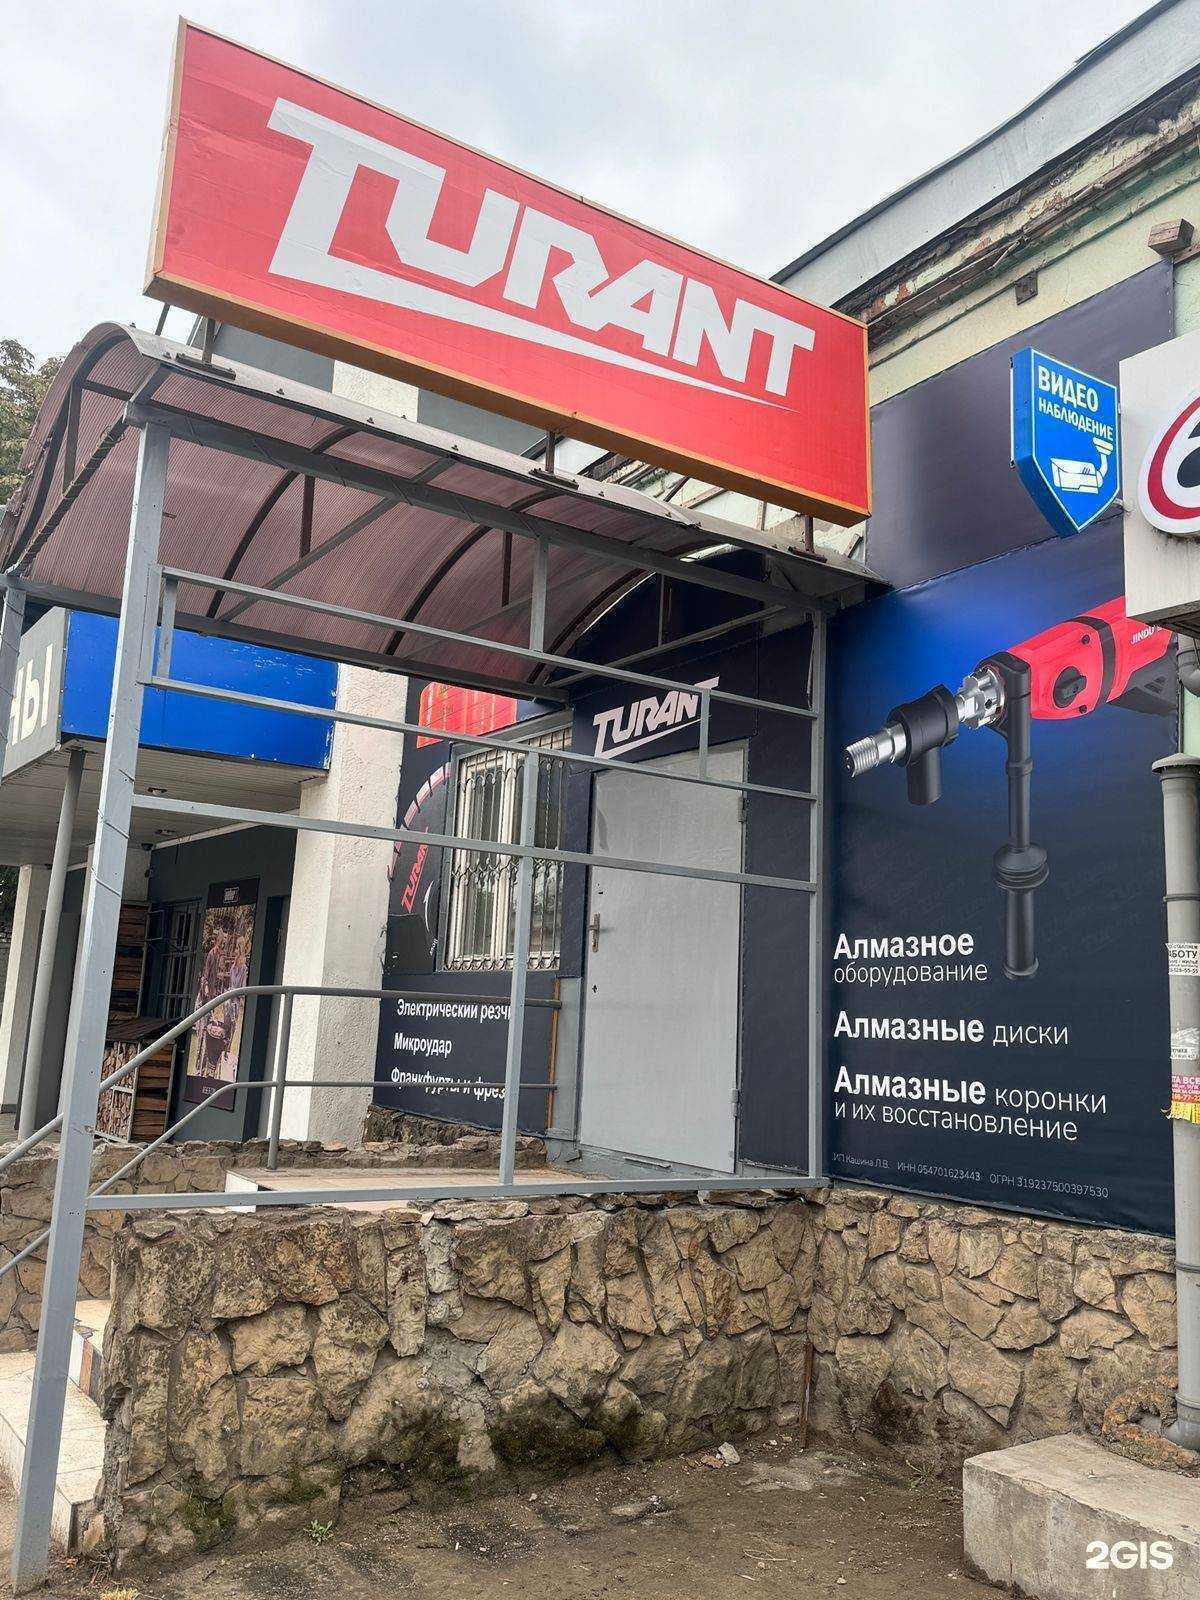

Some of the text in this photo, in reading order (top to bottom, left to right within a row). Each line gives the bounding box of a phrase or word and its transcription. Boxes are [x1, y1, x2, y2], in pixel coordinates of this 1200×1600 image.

[267, 97, 815, 413] TURANT
[1038, 365, 1099, 413] ВИДЕО
[1038, 397, 1114, 442] НАБЛЮДЕНИЕ
[833, 933, 974, 960] Алмазное
[834, 962, 988, 988] оборудование
[397, 998, 478, 1020] Электрический
[833, 1010, 1068, 1047] Алмазные диски
[393, 1032, 452, 1058] Микроудар
[473, 1076, 506, 1102] фрез
[833, 1065, 1107, 1114] Алмазные коронки
[834, 1101, 1078, 1141] и их восстановление
[897, 1161, 916, 1173] ИНН
[989, 1173, 1015, 1186] ОГРН
